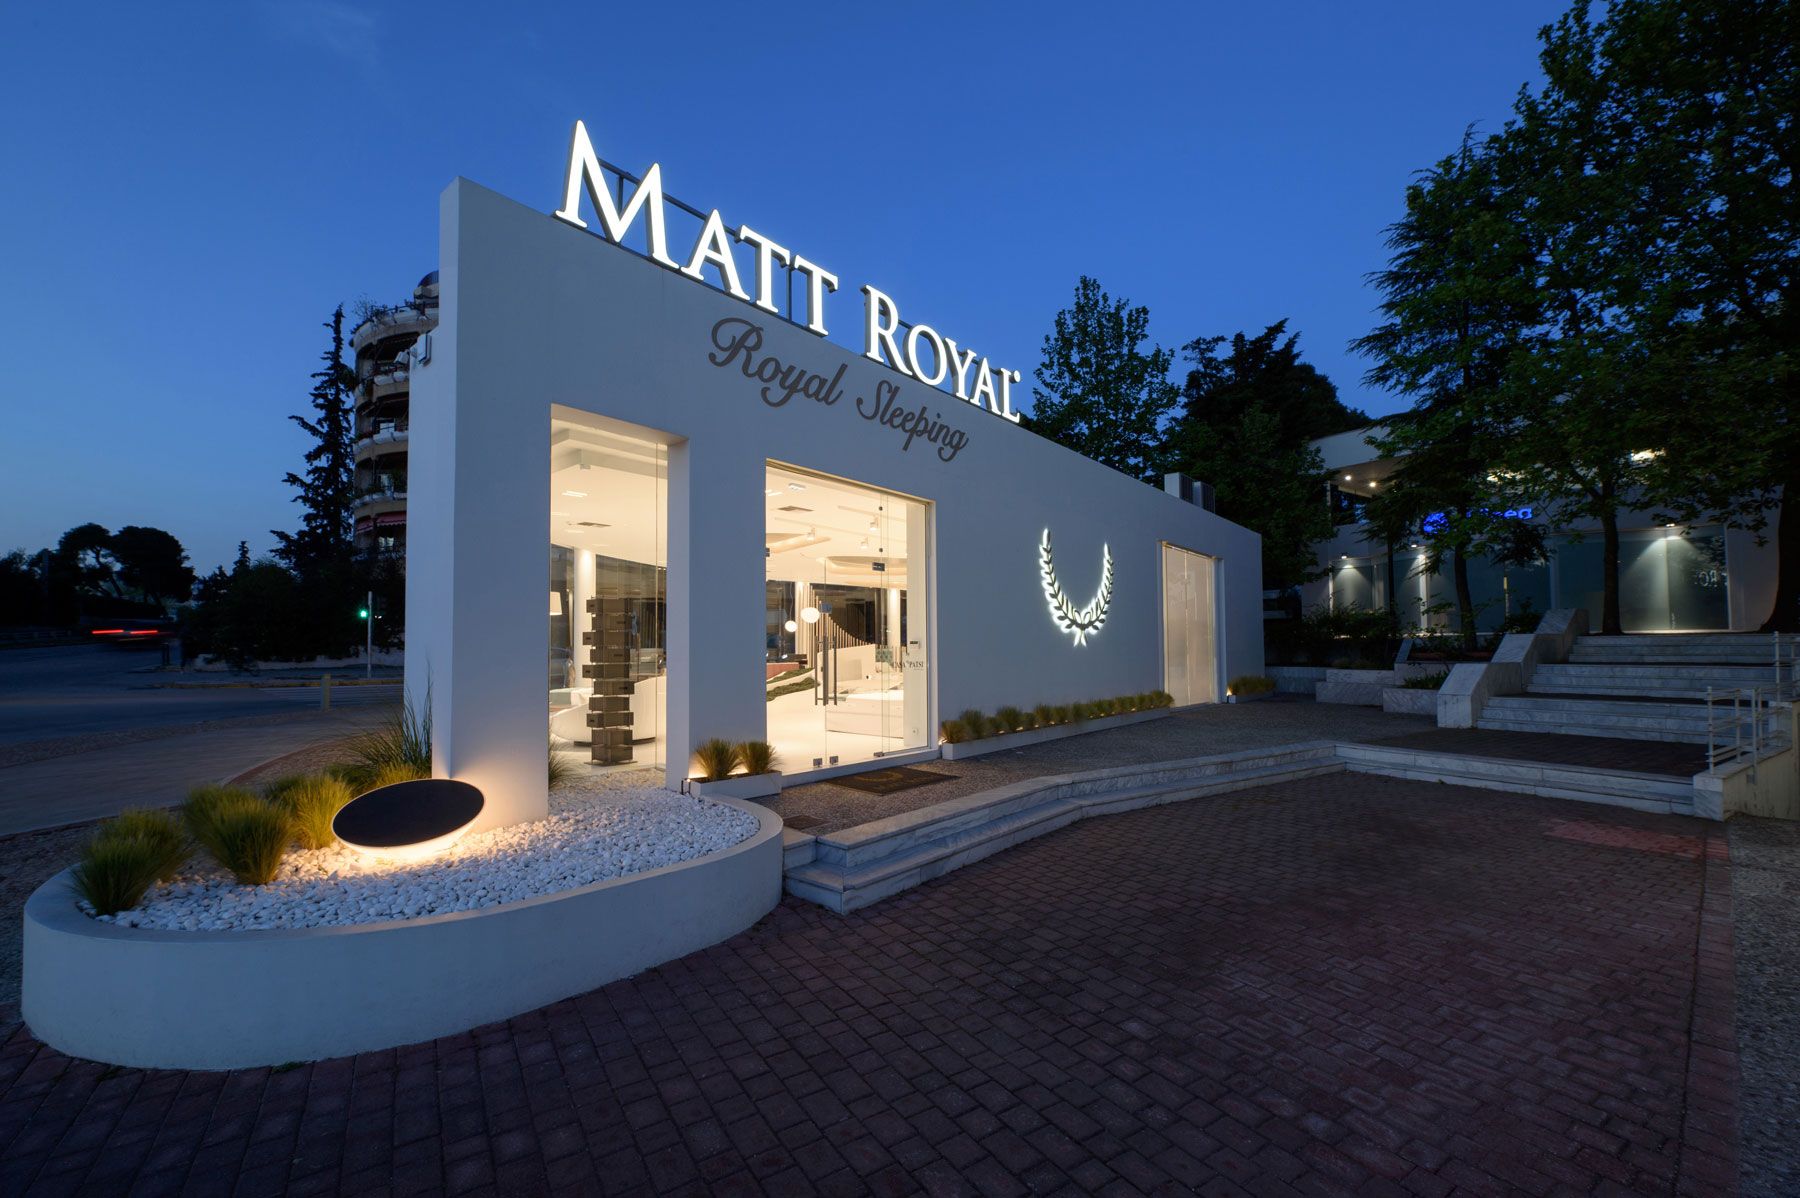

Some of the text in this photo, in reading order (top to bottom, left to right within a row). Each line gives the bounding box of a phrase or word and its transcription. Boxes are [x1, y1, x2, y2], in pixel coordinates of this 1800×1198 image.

[555, 119, 1021, 423] MATT ROYAL
[708, 317, 969, 462] Royal Sleeping
